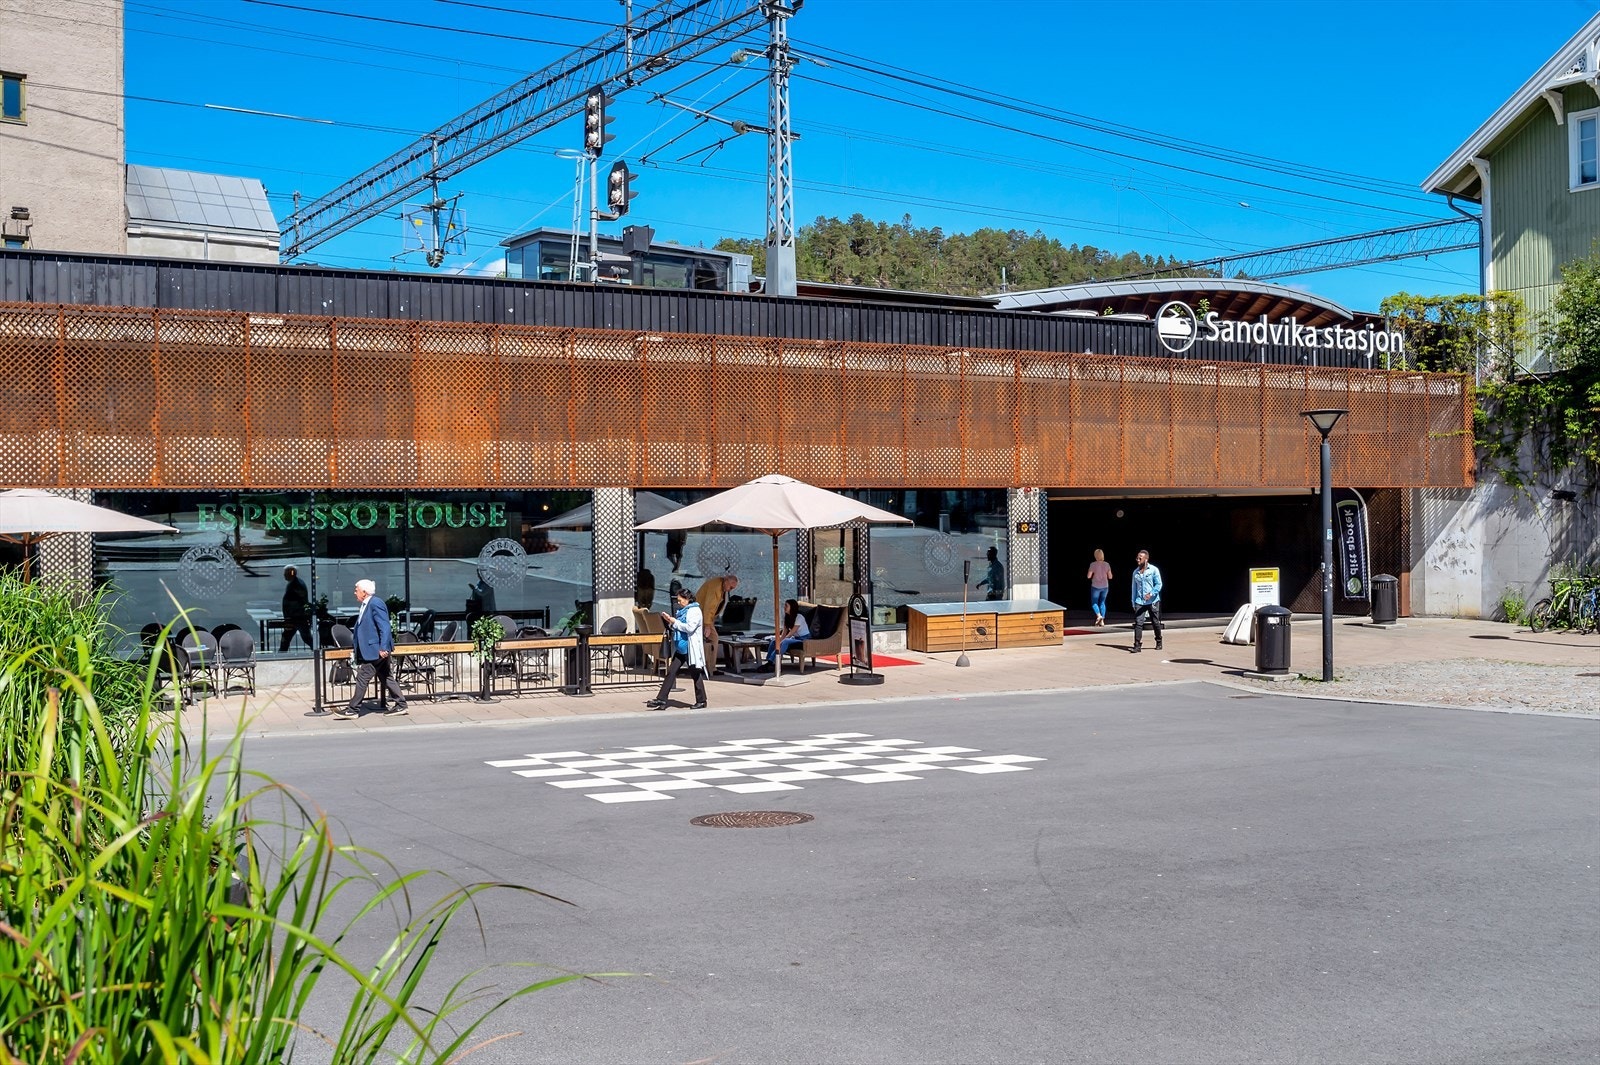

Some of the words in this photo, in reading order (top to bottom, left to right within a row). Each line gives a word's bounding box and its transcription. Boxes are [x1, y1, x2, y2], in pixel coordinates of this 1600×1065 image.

[1205, 311, 1318, 348] Sandvika
[1324, 323, 1403, 358] stasjon
[196, 502, 378, 531] ESPRESSO
[387, 501, 507, 528] HOUSE
